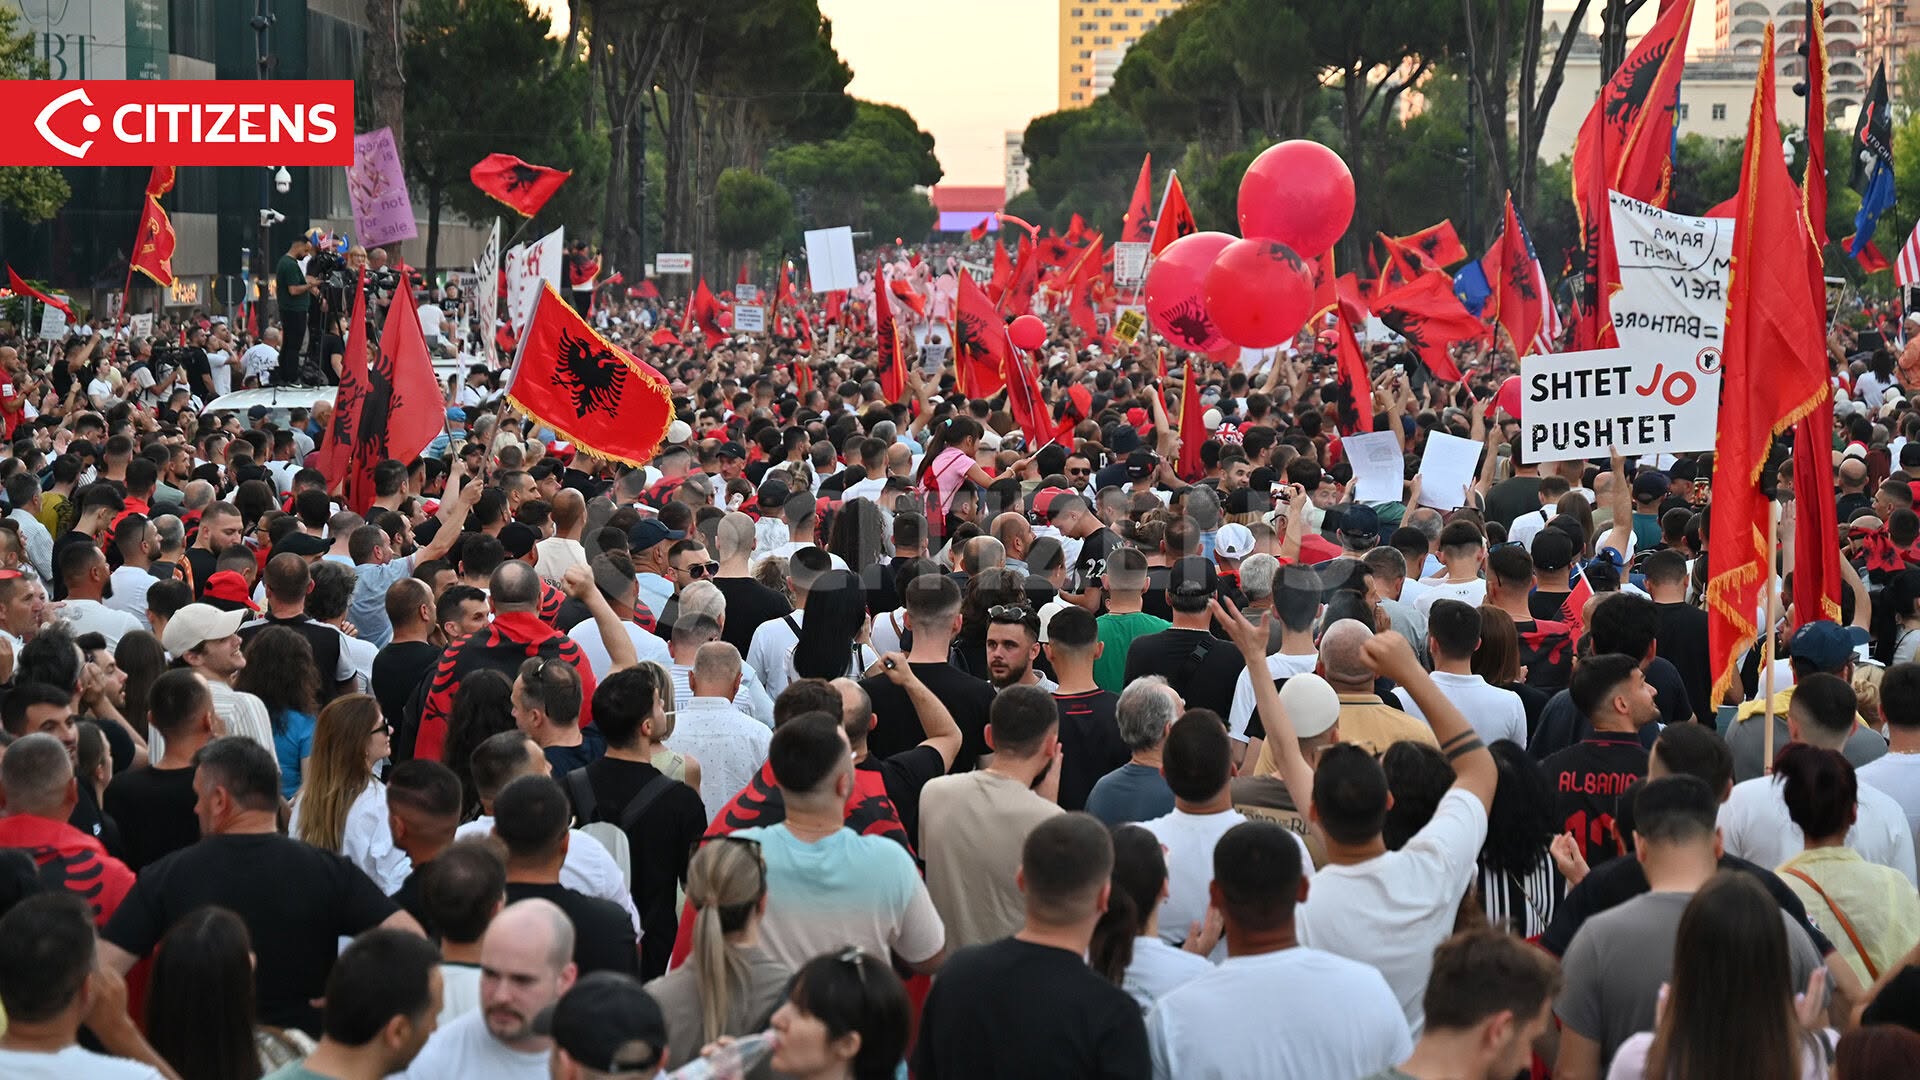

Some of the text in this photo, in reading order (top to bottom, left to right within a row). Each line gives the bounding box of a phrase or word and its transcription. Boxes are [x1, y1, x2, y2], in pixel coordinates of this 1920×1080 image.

[382, 151, 393, 161] is
[381, 197, 405, 210] not
[1530, 363, 1697, 406] SHTET JO
[1532, 413, 1676, 452] PUSHTET
[1085, 558, 1107, 579] 22
